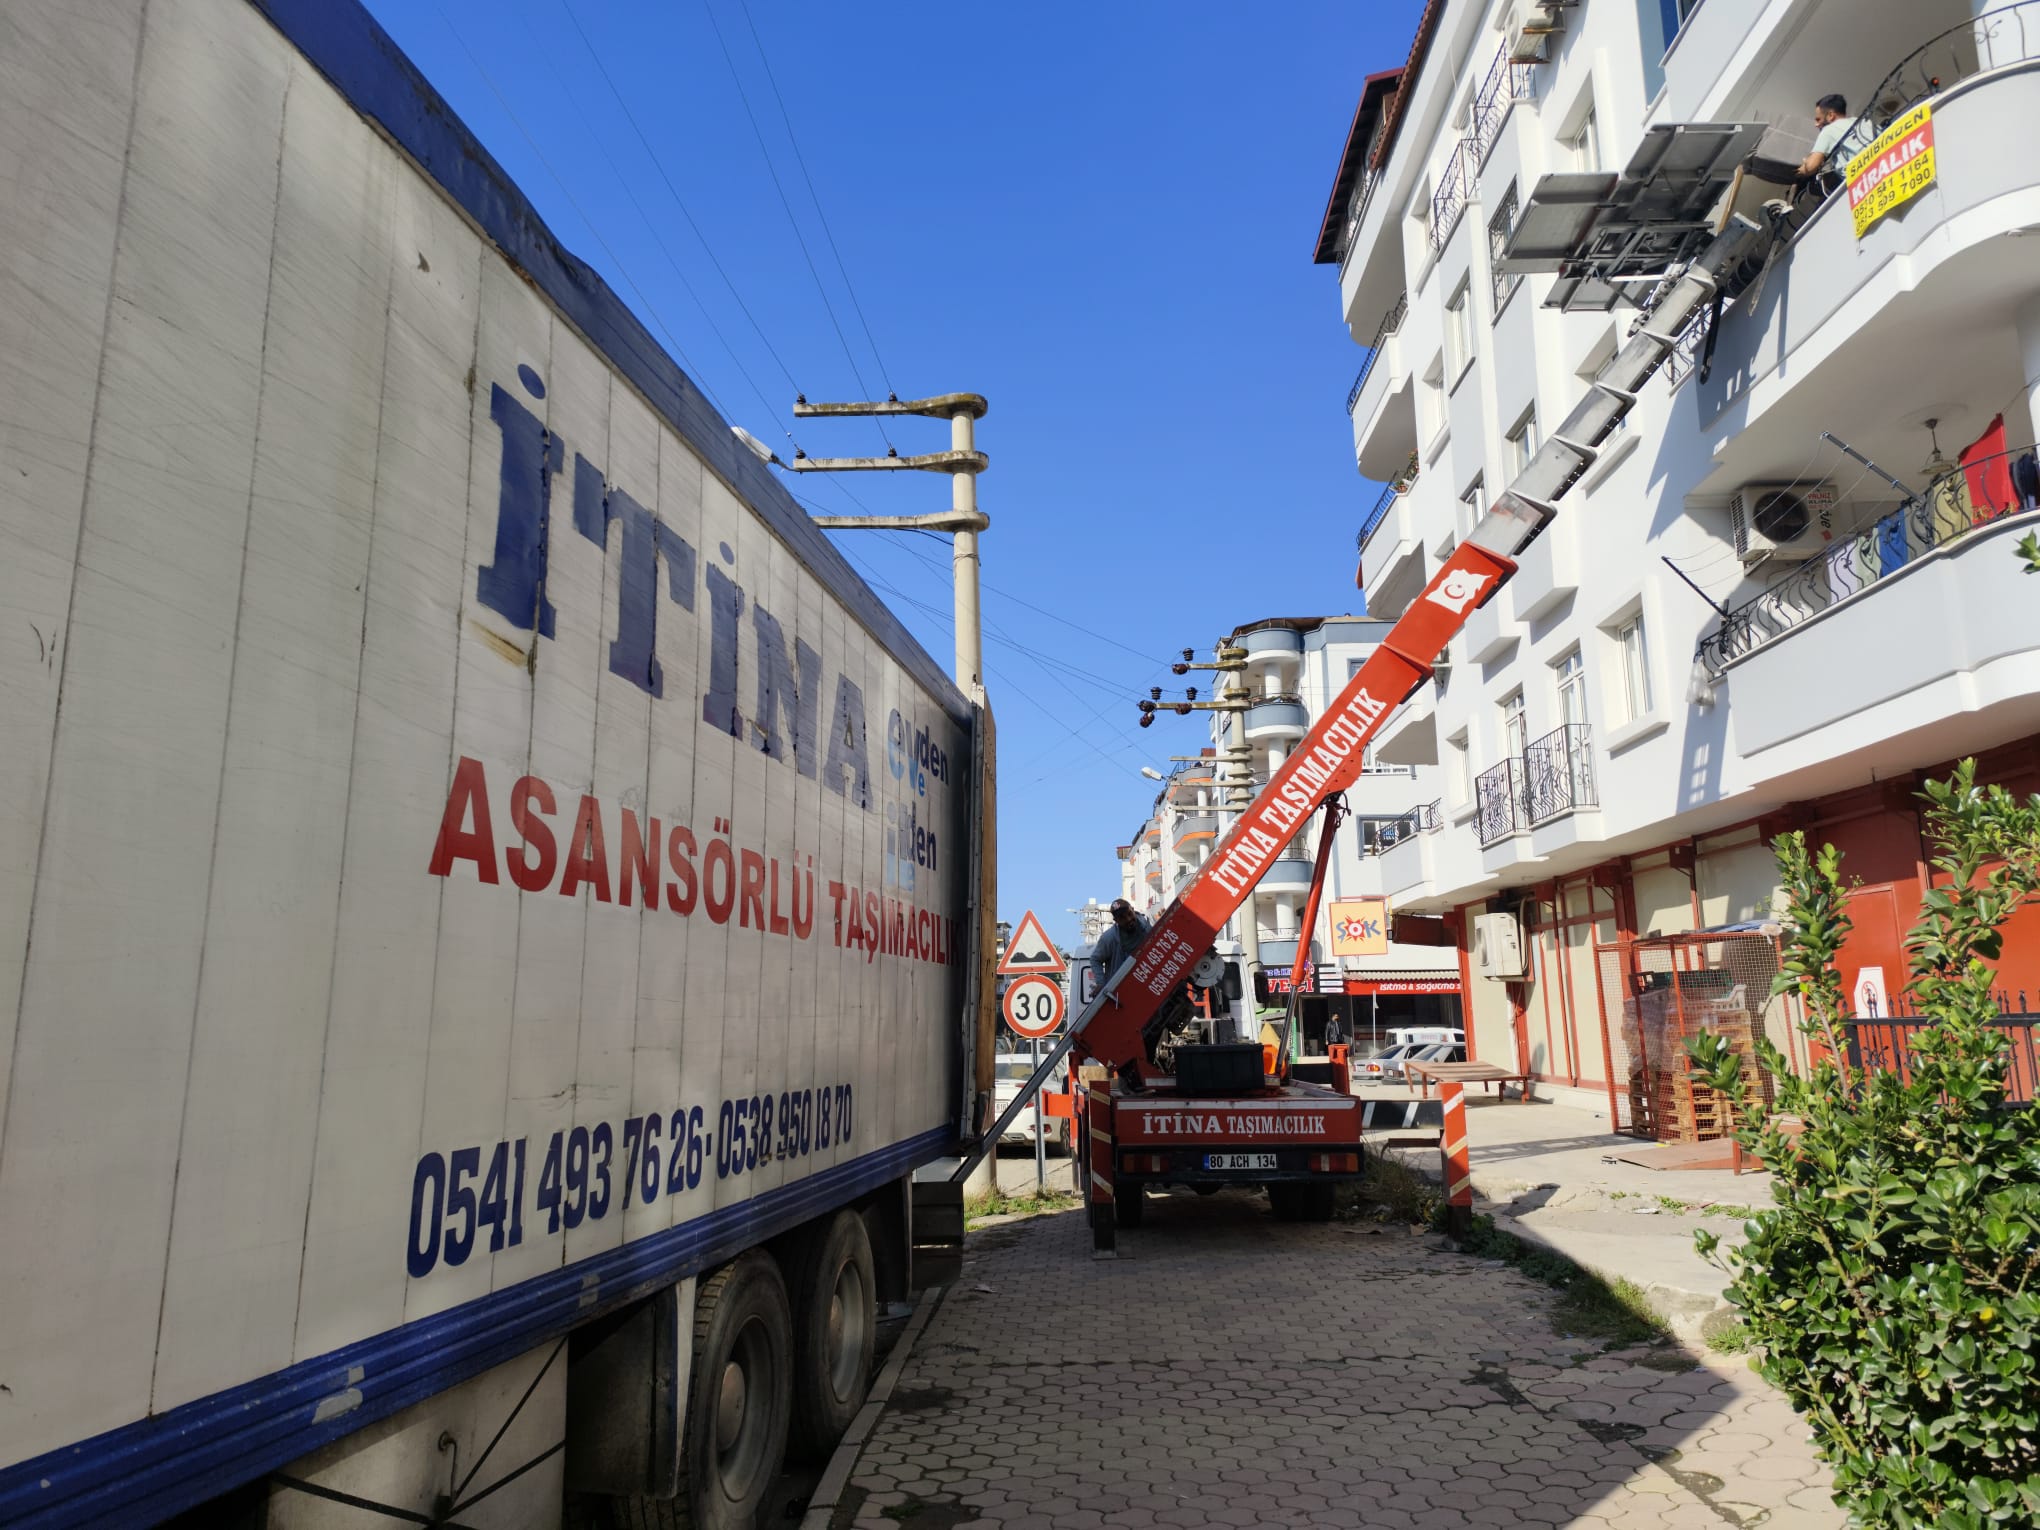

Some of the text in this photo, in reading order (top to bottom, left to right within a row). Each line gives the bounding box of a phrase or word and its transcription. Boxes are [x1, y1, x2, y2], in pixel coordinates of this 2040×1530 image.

[1900, 153, 1929, 180] 1164
[1900, 167, 1931, 195] 7090
[477, 363, 874, 810] İTİNA
[1208, 687, 1388, 898] İTİNA TAŞIMACILIK
[427, 756, 960, 966] ASANSÖRLÜ TAŞIMACILIK
[1335, 918, 1382, 945] ŞOK
[1132, 929, 1179, 983] 0541 493 76 26
[1148, 941, 1194, 996] 0538 950 18 70
[1015, 992, 1052, 1021] 30
[1142, 1112, 1326, 1138] İTİNA TAŞIMACILIK
[406, 1135, 528, 1279] 0541
[536, 1121, 613, 1235] 493
[622, 1112, 663, 1210] 76
[666, 1105, 704, 1196] 26
[716, 1093, 774, 1180] 0538
[778, 1088, 813, 1161] 950
[815, 1085, 832, 1152] 18
[835, 1083, 853, 1146] 70
[1210, 1155, 1276, 1168] 80 ACH 134
